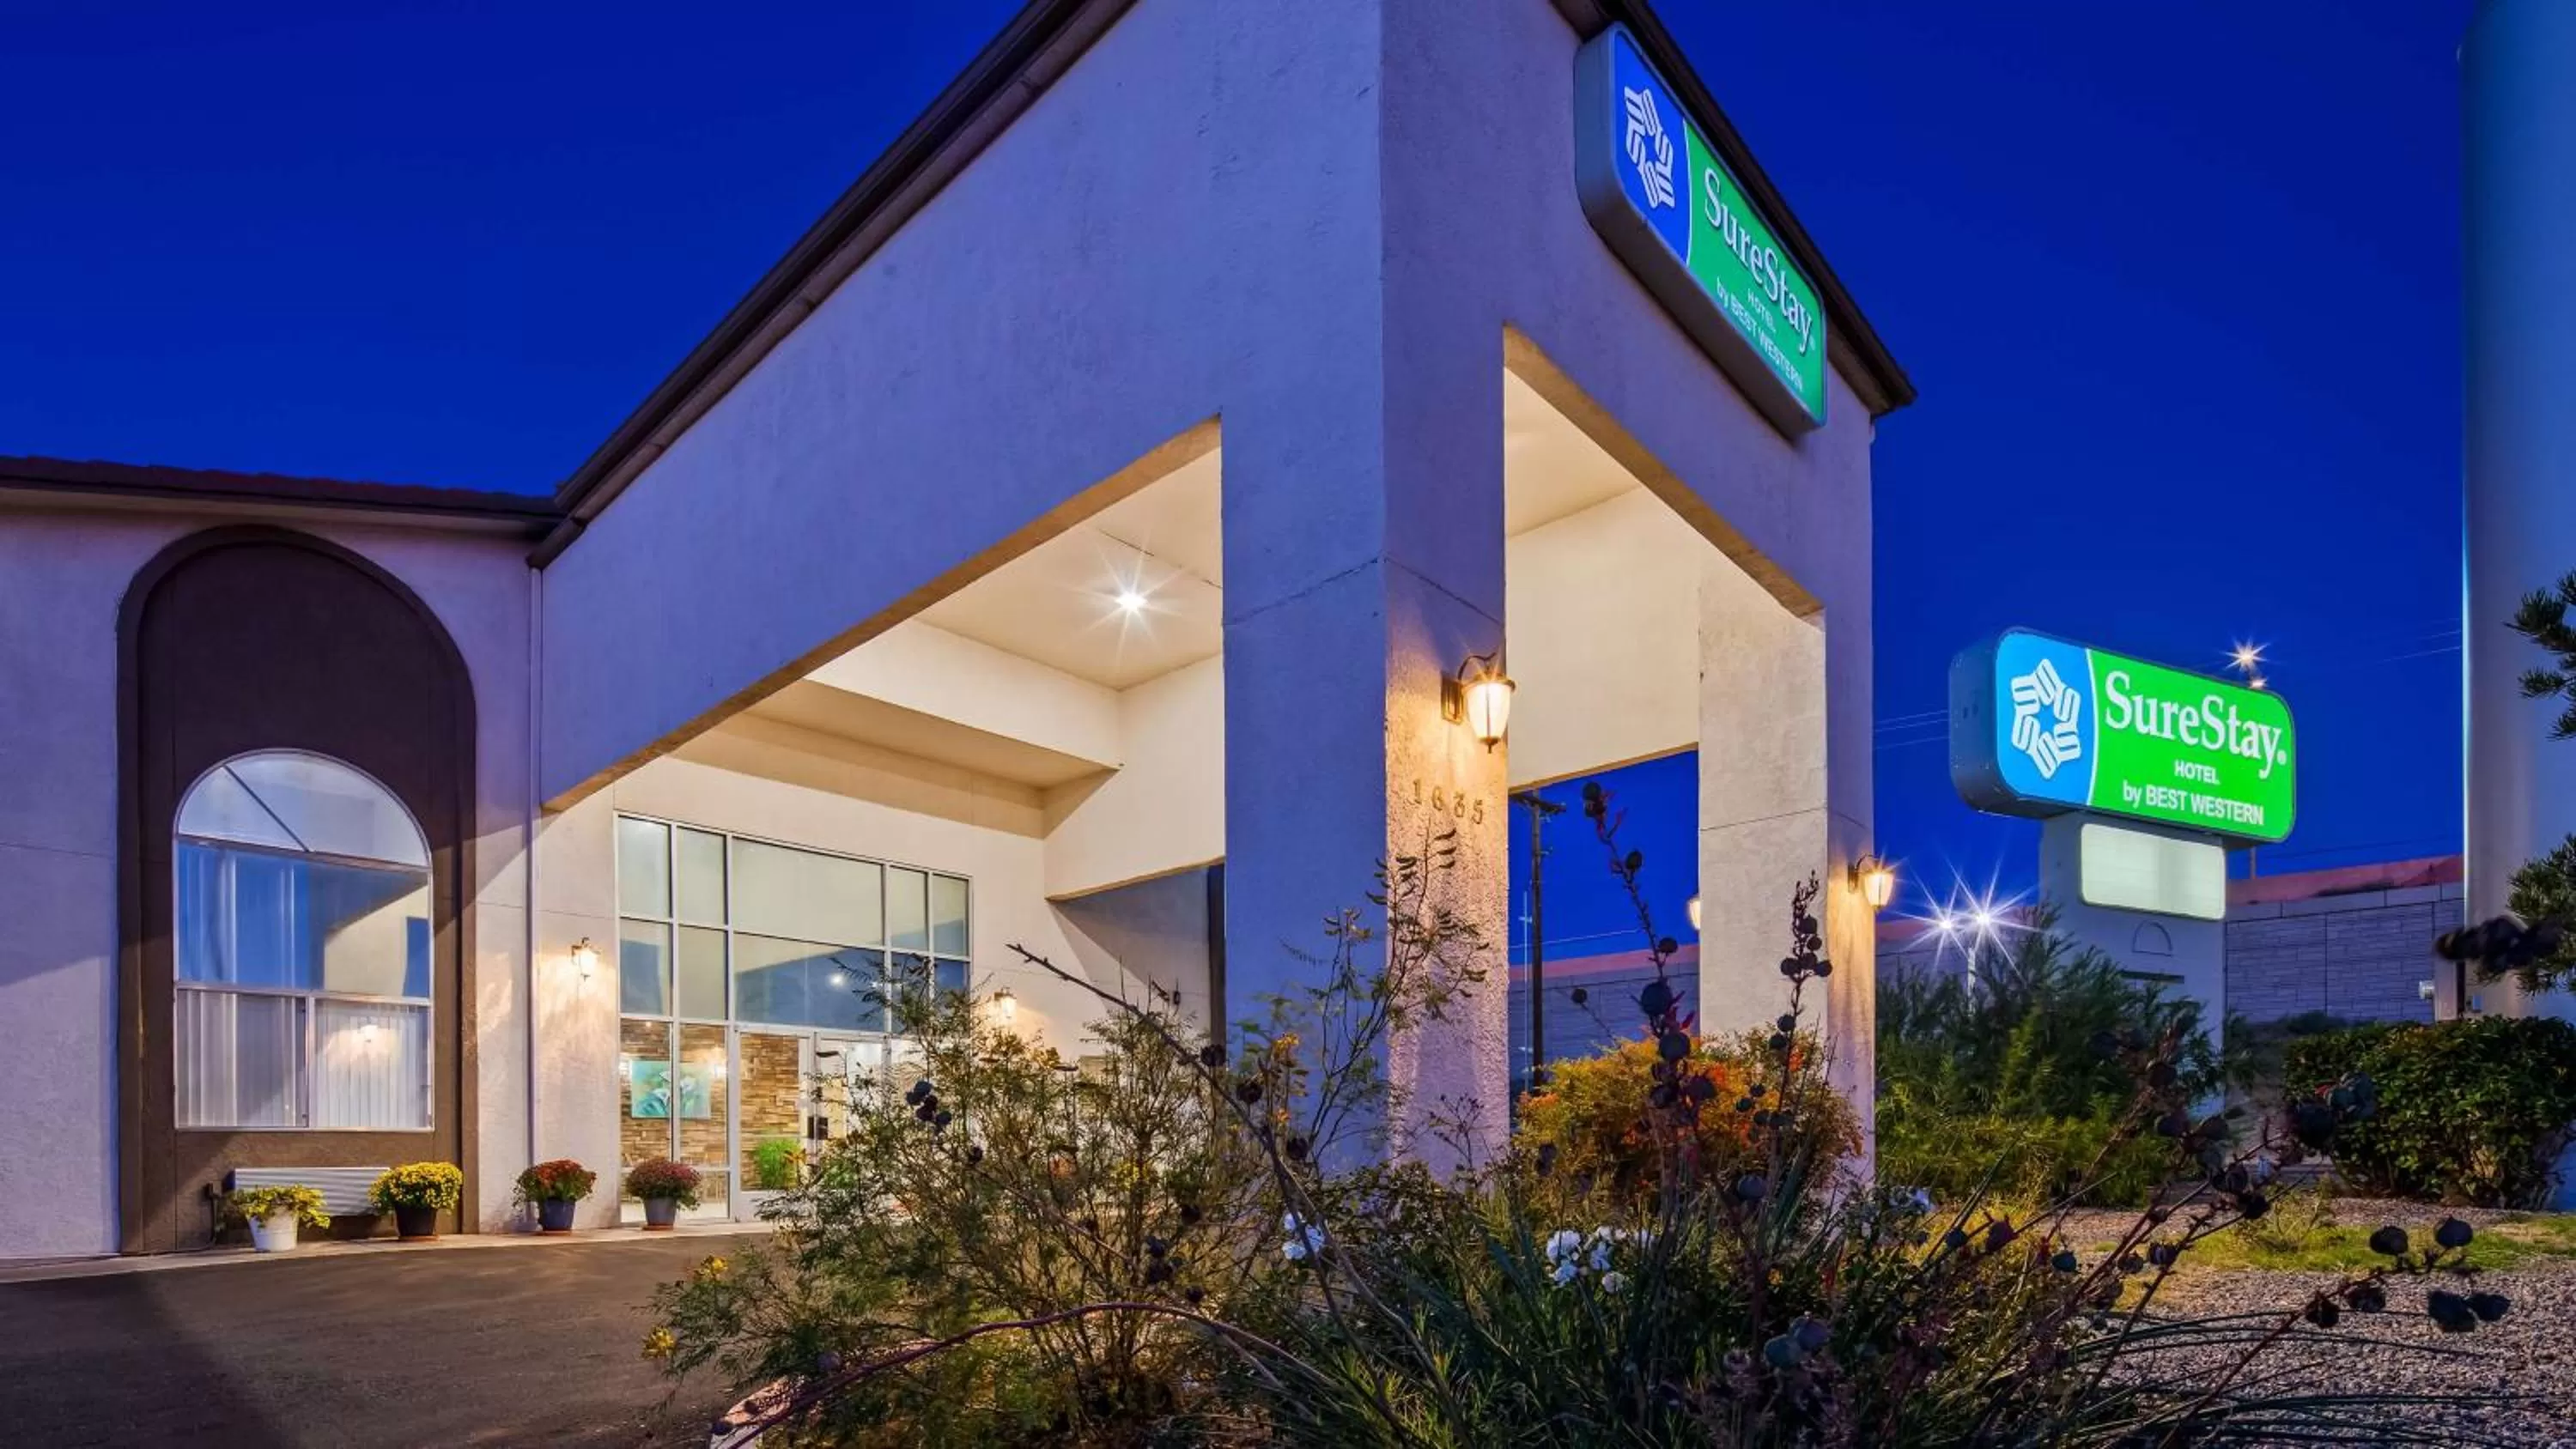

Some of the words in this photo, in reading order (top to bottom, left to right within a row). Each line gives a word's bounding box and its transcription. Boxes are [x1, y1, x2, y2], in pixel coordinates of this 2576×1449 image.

[1704, 167, 1814, 354] SureStay
[1716, 275, 1728, 308] by
[1730, 291, 1757, 337] BEST
[1758, 326, 1803, 392] WESTERN
[1747, 288, 1777, 334] HOTEL
[2105, 670, 2283, 779] SureStay
[2123, 779, 2142, 809] by
[2146, 783, 2186, 811] BEST
[2190, 792, 2265, 826] WESTERN
[2174, 759, 2219, 785] HOTEL
